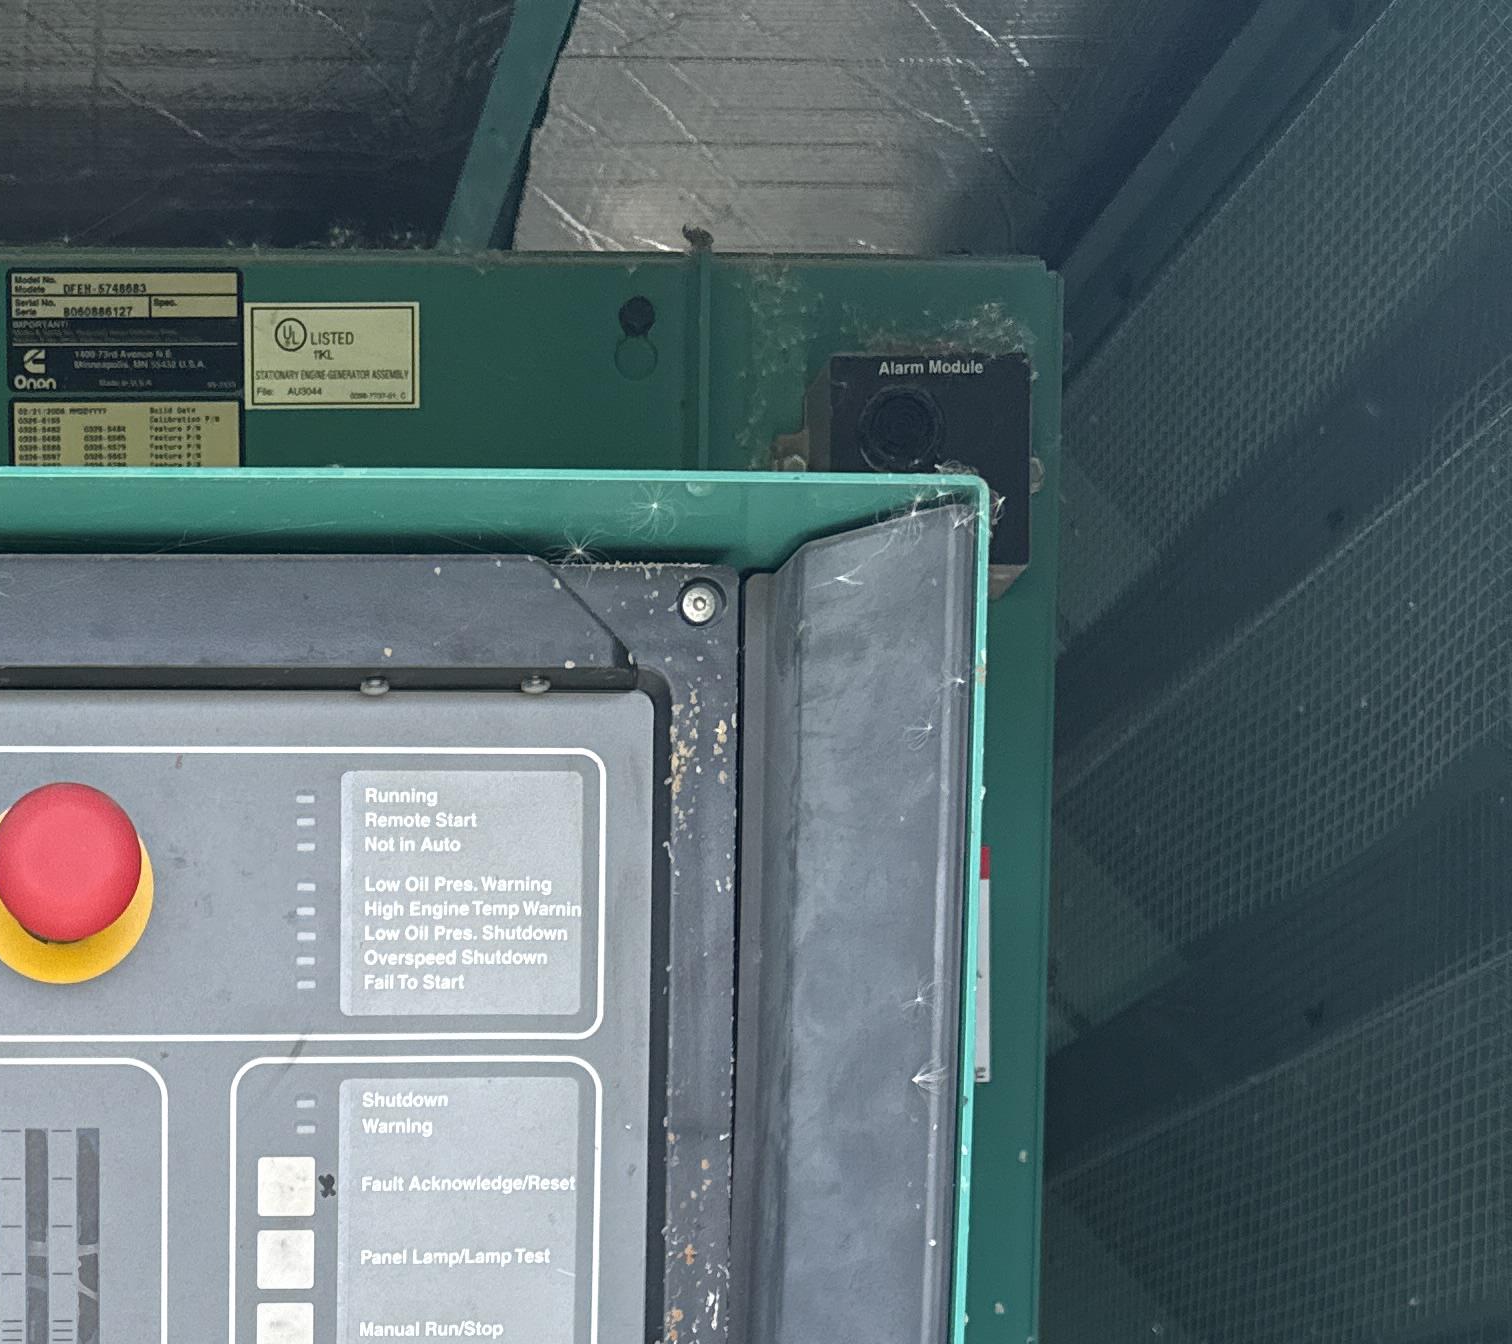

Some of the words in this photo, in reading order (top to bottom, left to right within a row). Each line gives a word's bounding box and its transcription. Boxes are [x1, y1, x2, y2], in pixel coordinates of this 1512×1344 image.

[310, 331, 355, 345] LISTED
[879, 361, 924, 376] Alarm
[928, 359, 984, 375] Module
[14, 375, 57, 390] Onan
[364, 788, 439, 807] Running
[364, 813, 431, 828] Remote
[435, 812, 477, 828] Start
[364, 837, 395, 852] Not
[399, 837, 416, 852] in
[421, 837, 462, 852] Auto
[364, 877, 400, 892] Low
[405, 877, 429, 892] Oil
[434, 877, 478, 892] Pres.
[481, 877, 553, 895] Warning
[364, 902, 404, 920] High
[410, 902, 470, 920] Engine
[472, 901, 520, 920] Temp
[364, 926, 400, 941] Low
[405, 926, 429, 941] Oil
[434, 926, 478, 941] Pres.
[482, 926, 568, 941] Shutdown
[364, 950, 457, 969] Overspeed
[462, 949, 548, 965] Shutdown
[364, 974, 394, 989] Fail
[398, 974, 418, 989] To
[423, 974, 465, 989] Start
[362, 1092, 449, 1108] Shutdown
[362, 1118, 433, 1137] Warning
[361, 1175, 404, 1192] Fault
[409, 1175, 576, 1194] Acknowledge/Reset
[360, 1250, 407, 1265] Panel
[413, 1249, 511, 1267] Lamp/Lamp
[514, 1249, 551, 1264] Test
[359, 1321, 419, 1337] Manual
[425, 1321, 503, 1339] Run/Stop
